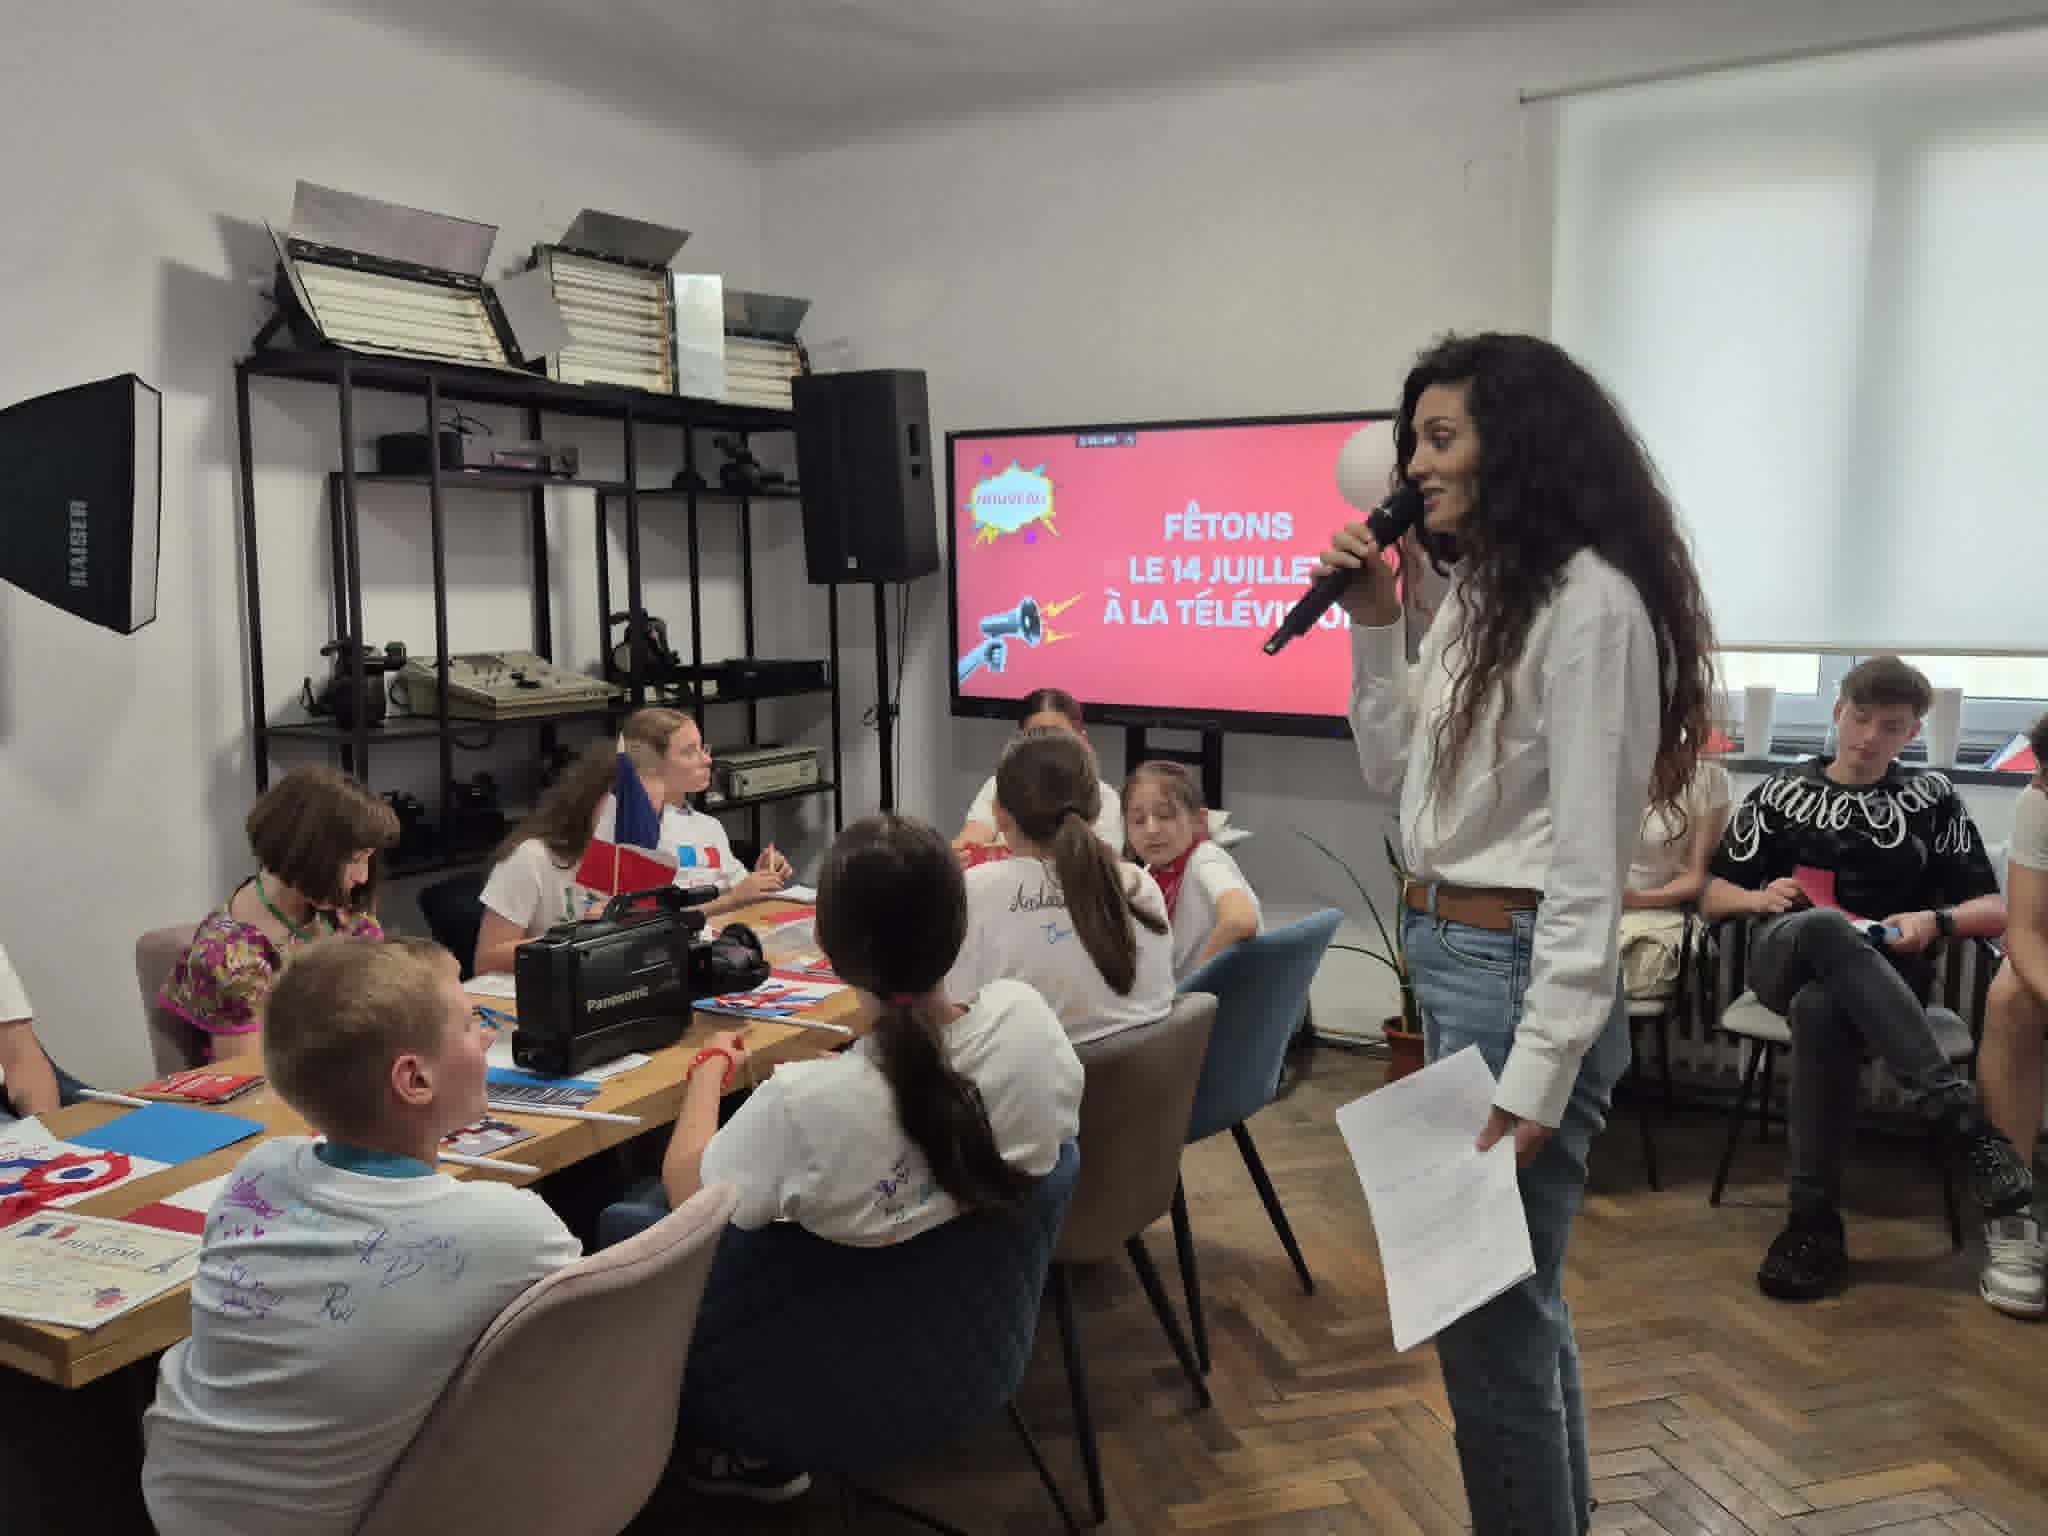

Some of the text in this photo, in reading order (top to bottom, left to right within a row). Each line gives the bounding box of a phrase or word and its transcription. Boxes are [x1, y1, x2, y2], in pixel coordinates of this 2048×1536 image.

[1163, 499, 1294, 541] FÊTONS
[1129, 556, 1164, 584] LE
[1171, 556, 1202, 584] 14
[1103, 588, 1125, 625] À
[1131, 600, 1169, 625] LA
